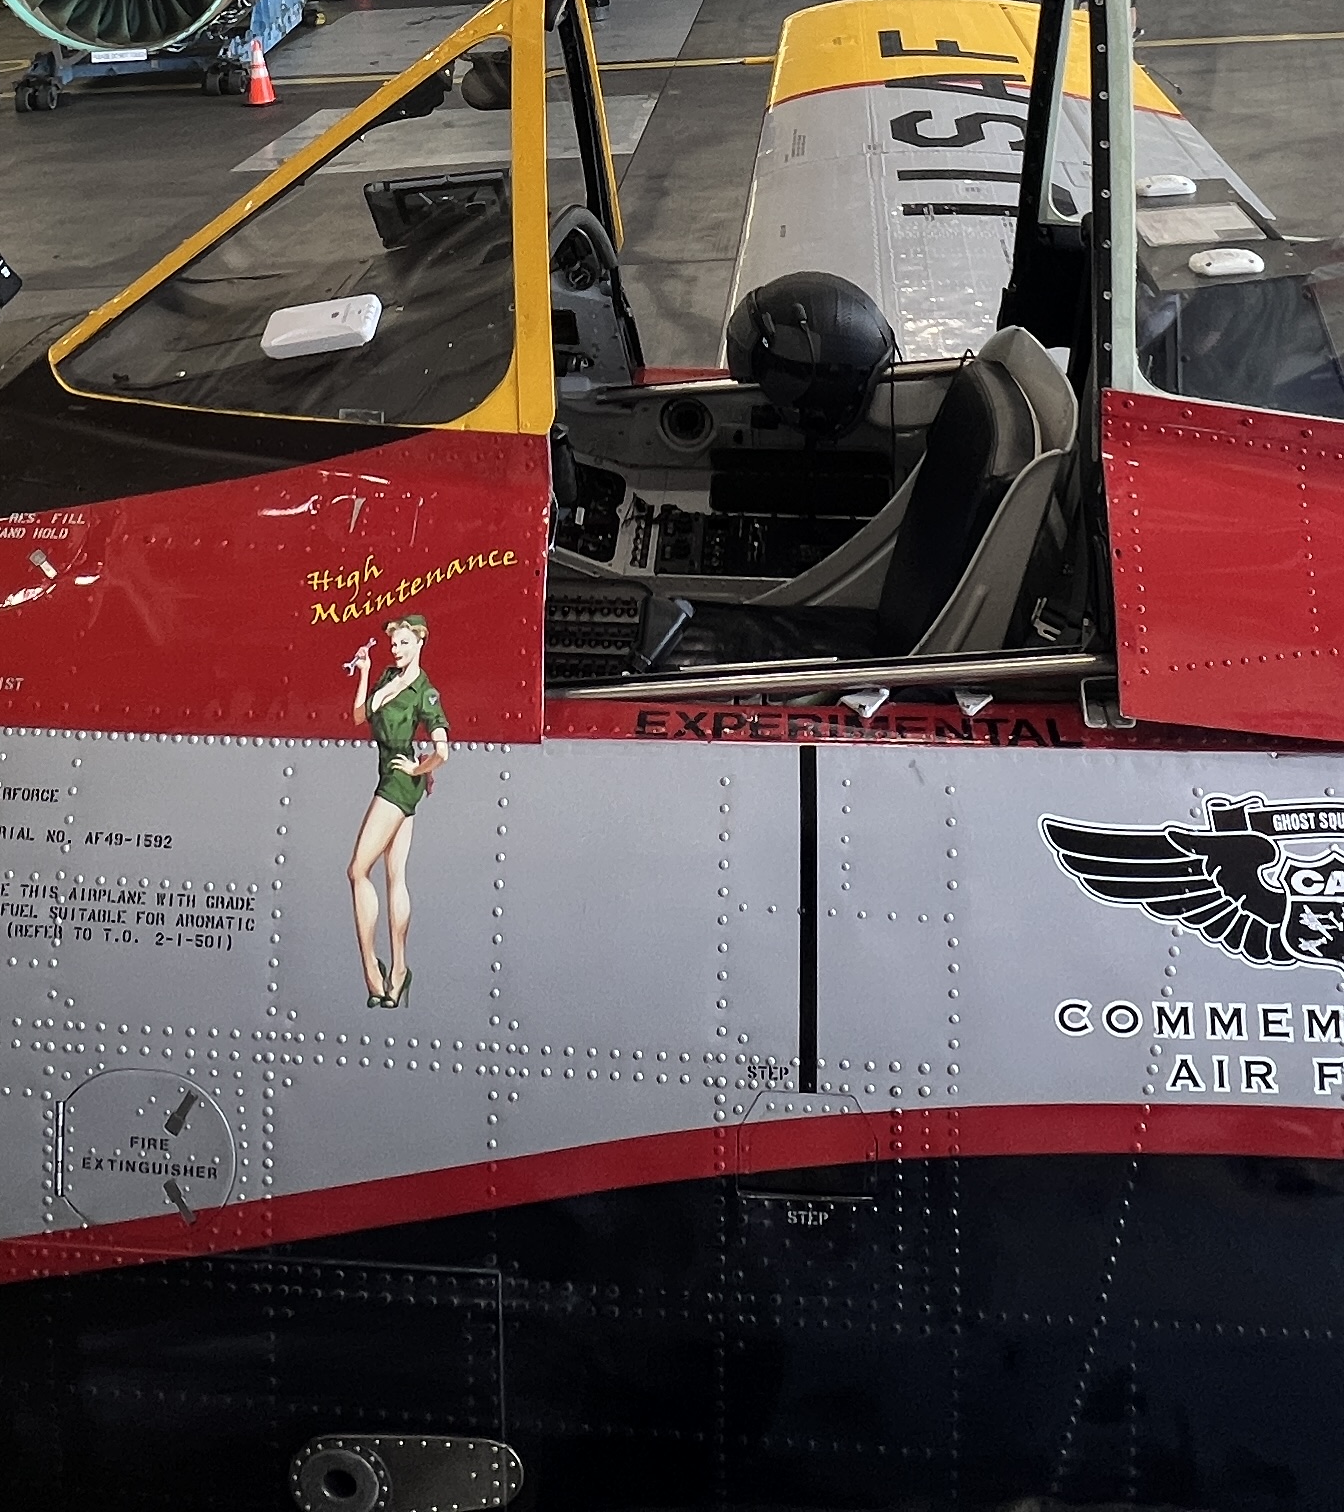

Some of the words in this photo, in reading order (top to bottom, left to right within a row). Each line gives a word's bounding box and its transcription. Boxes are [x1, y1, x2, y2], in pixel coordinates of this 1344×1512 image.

[50, 512, 86, 525] FILL
[32, 527, 69, 540] HOLD
[306, 554, 384, 602] High
[310, 549, 519, 625] Maintenance
[636, 708, 1084, 749] EXPERIMENTAL
[1272, 812, 1316, 832] GHOST
[46, 829, 72, 845] NO.
[84, 831, 173, 849] AF49-1592
[20, 883, 59, 900] THIS
[68, 886, 147, 906] AIRPLANE
[156, 892, 196, 908] WITH
[206, 895, 256, 912] GRADE
[0, 902, 38, 919] FUEL
[49, 905, 127, 924] SUITABLE
[136, 911, 165, 926] FOR
[176, 913, 256, 932] AROMATIC
[7, 921, 63, 939] (REFER
[74, 926, 92, 941] TO
[103, 927, 139, 944] T.O.
[155, 931, 232, 952] 2-1-501)
[747, 1065, 789, 1081] STEP
[1166, 1057, 1280, 1094] AIR
[130, 1136, 169, 1151] FIRE
[82, 1157, 218, 1179] EXTINGUISHER
[787, 1210, 829, 1226] STEP
